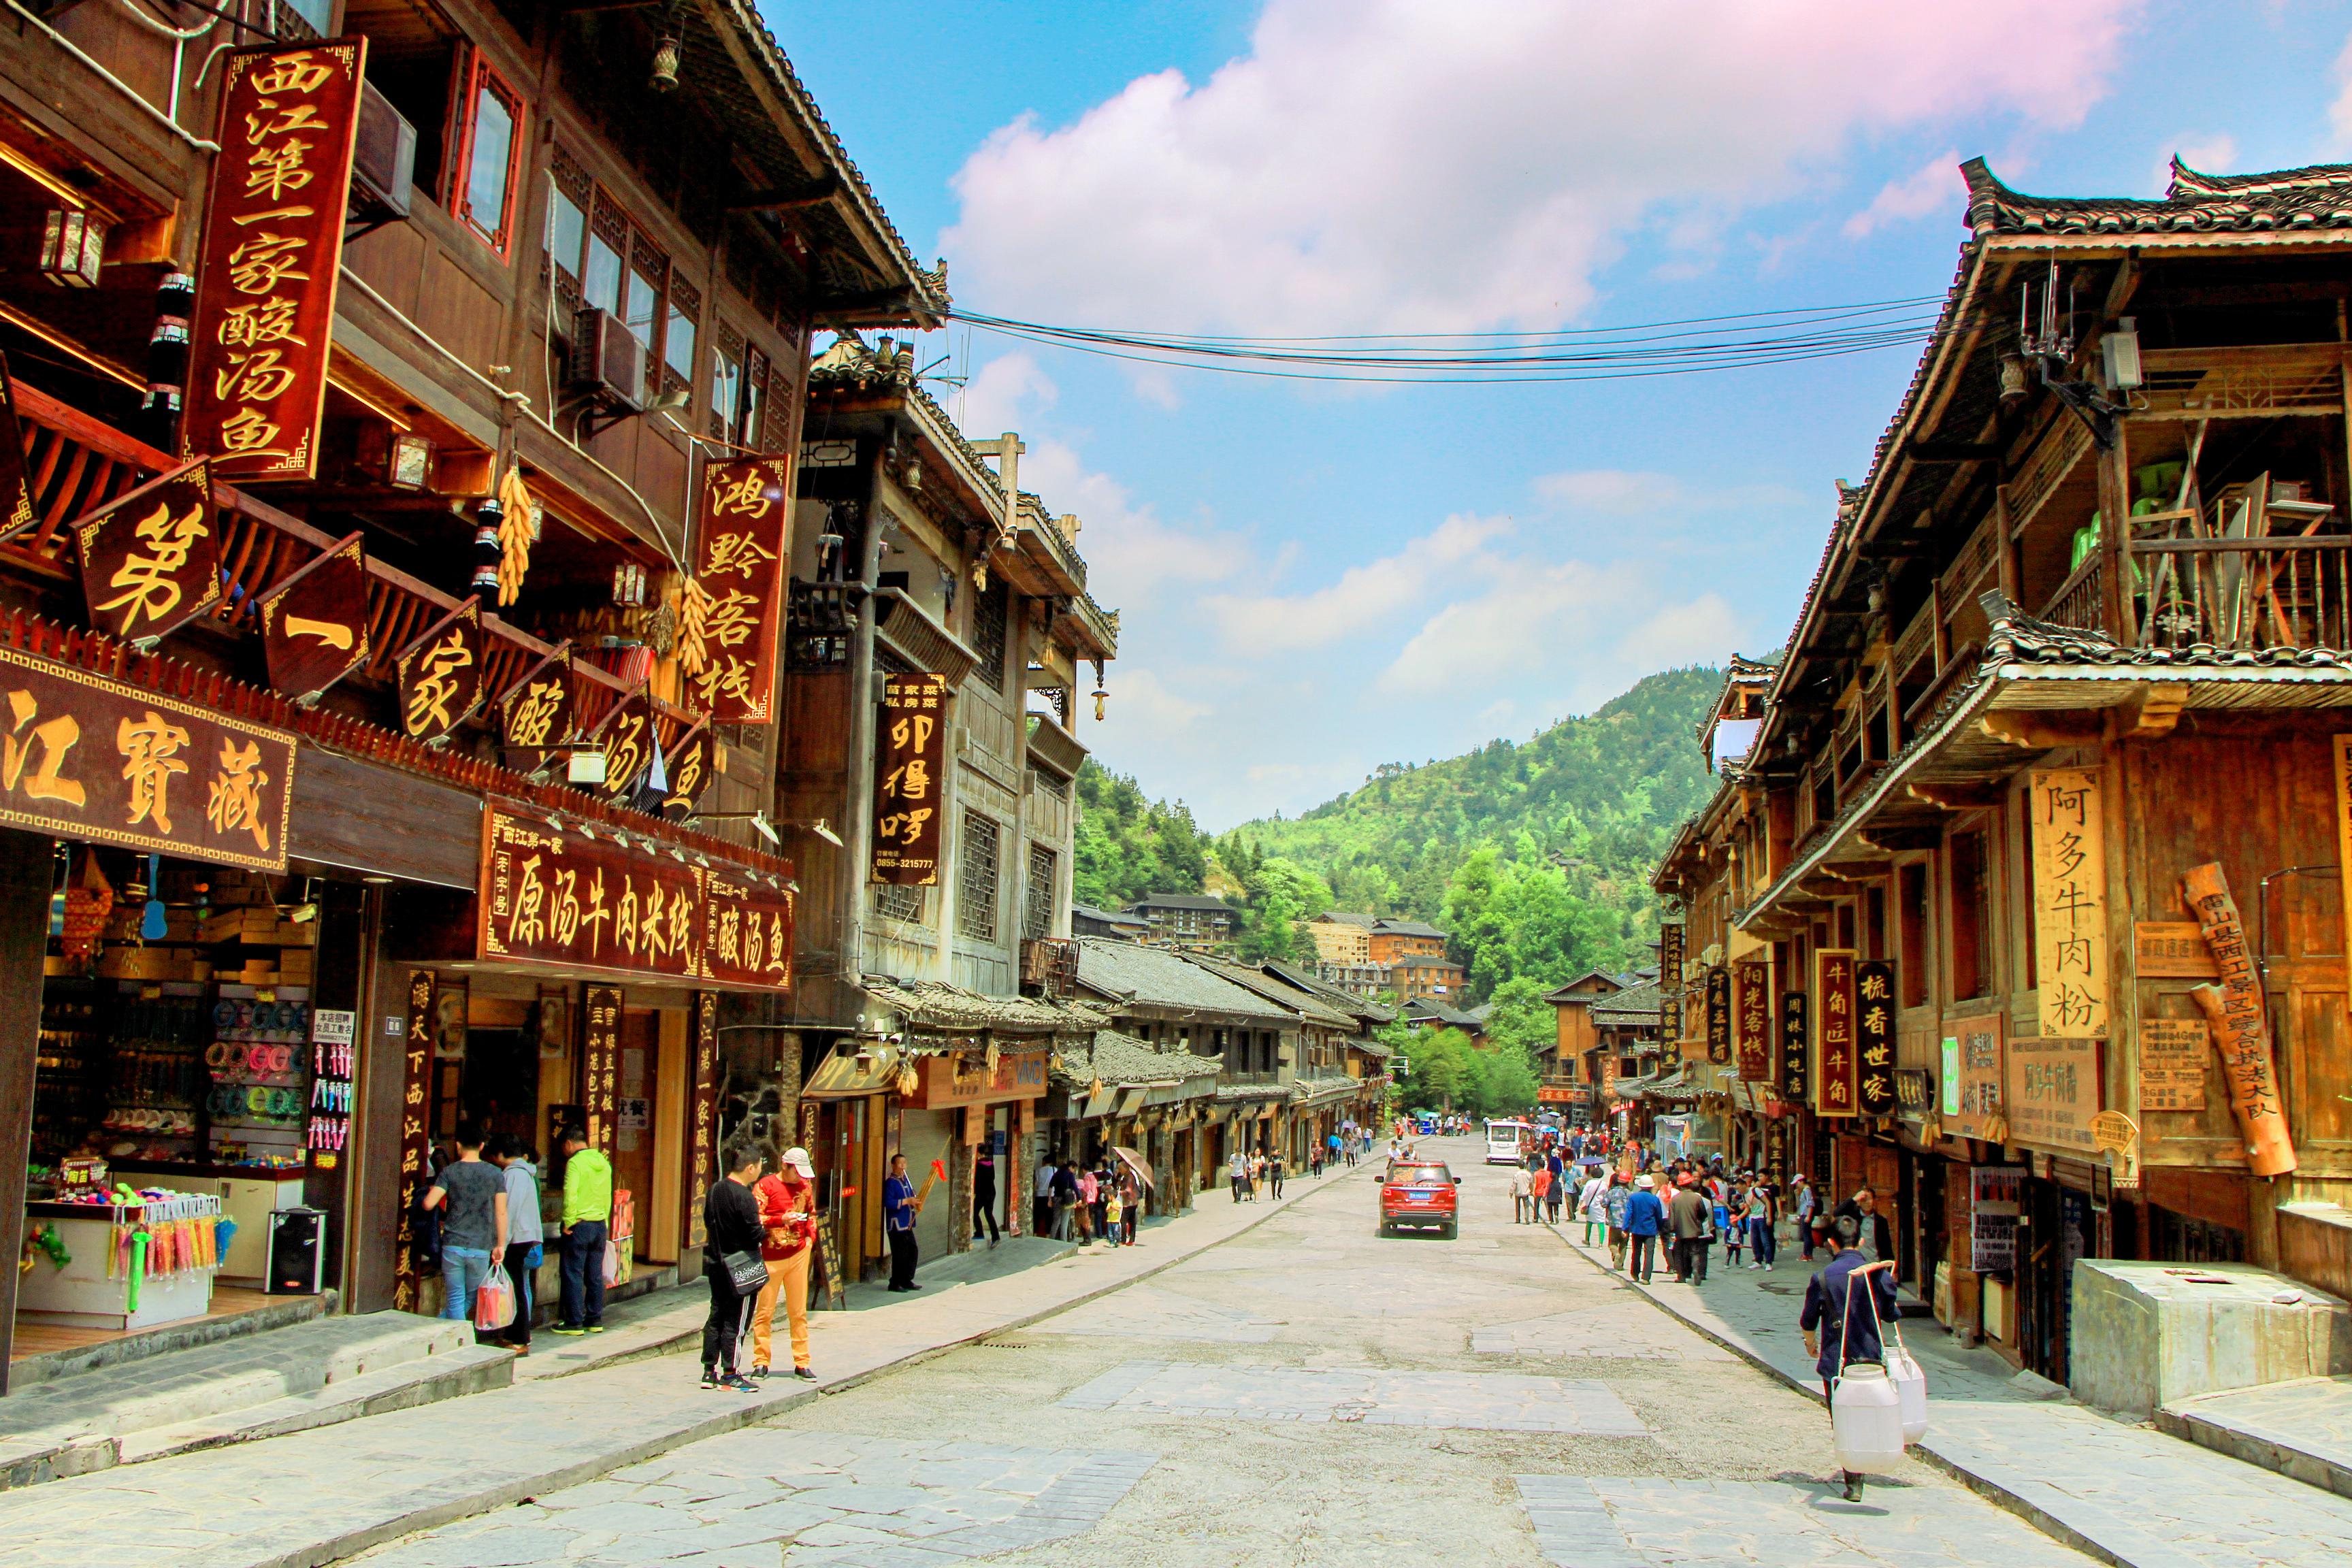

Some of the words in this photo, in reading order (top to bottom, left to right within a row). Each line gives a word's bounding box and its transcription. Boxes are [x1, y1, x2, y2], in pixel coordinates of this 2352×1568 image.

[212, 51, 333, 461] 西江第一家酸汤鱼
[696, 468, 777, 710] 鸿黔客栈
[285, 615, 353, 650] 一
[406, 628, 472, 736] 家
[885, 698, 937, 708] 私房菜
[886, 685, 938, 695] 苗家菜
[663, 741, 702, 810] 鱼
[504, 829, 563, 855] 西江第一家
[877, 859, 932, 868] 0855-3215777
[495, 856, 508, 913] 老字号
[509, 854, 693, 966] 原汤牛肉米线
[711, 880, 749, 900] 西江第一家
[2048, 786, 2101, 1027] 阿多牛肉粉
[718, 904, 785, 972] 酸汤鱼
[1743, 966, 1765, 1056] 阳光客栈
[1826, 962, 1848, 1103] 牛角匠牛角
[1860, 975, 1891, 1101] 梳香世家
[2199, 893, 2278, 1120] 雷山县西江景区综合执法大队
[587, 1033, 601, 1112] 小笼包子
[693, 1000, 713, 1200] 西江第一家酸汤鱼
